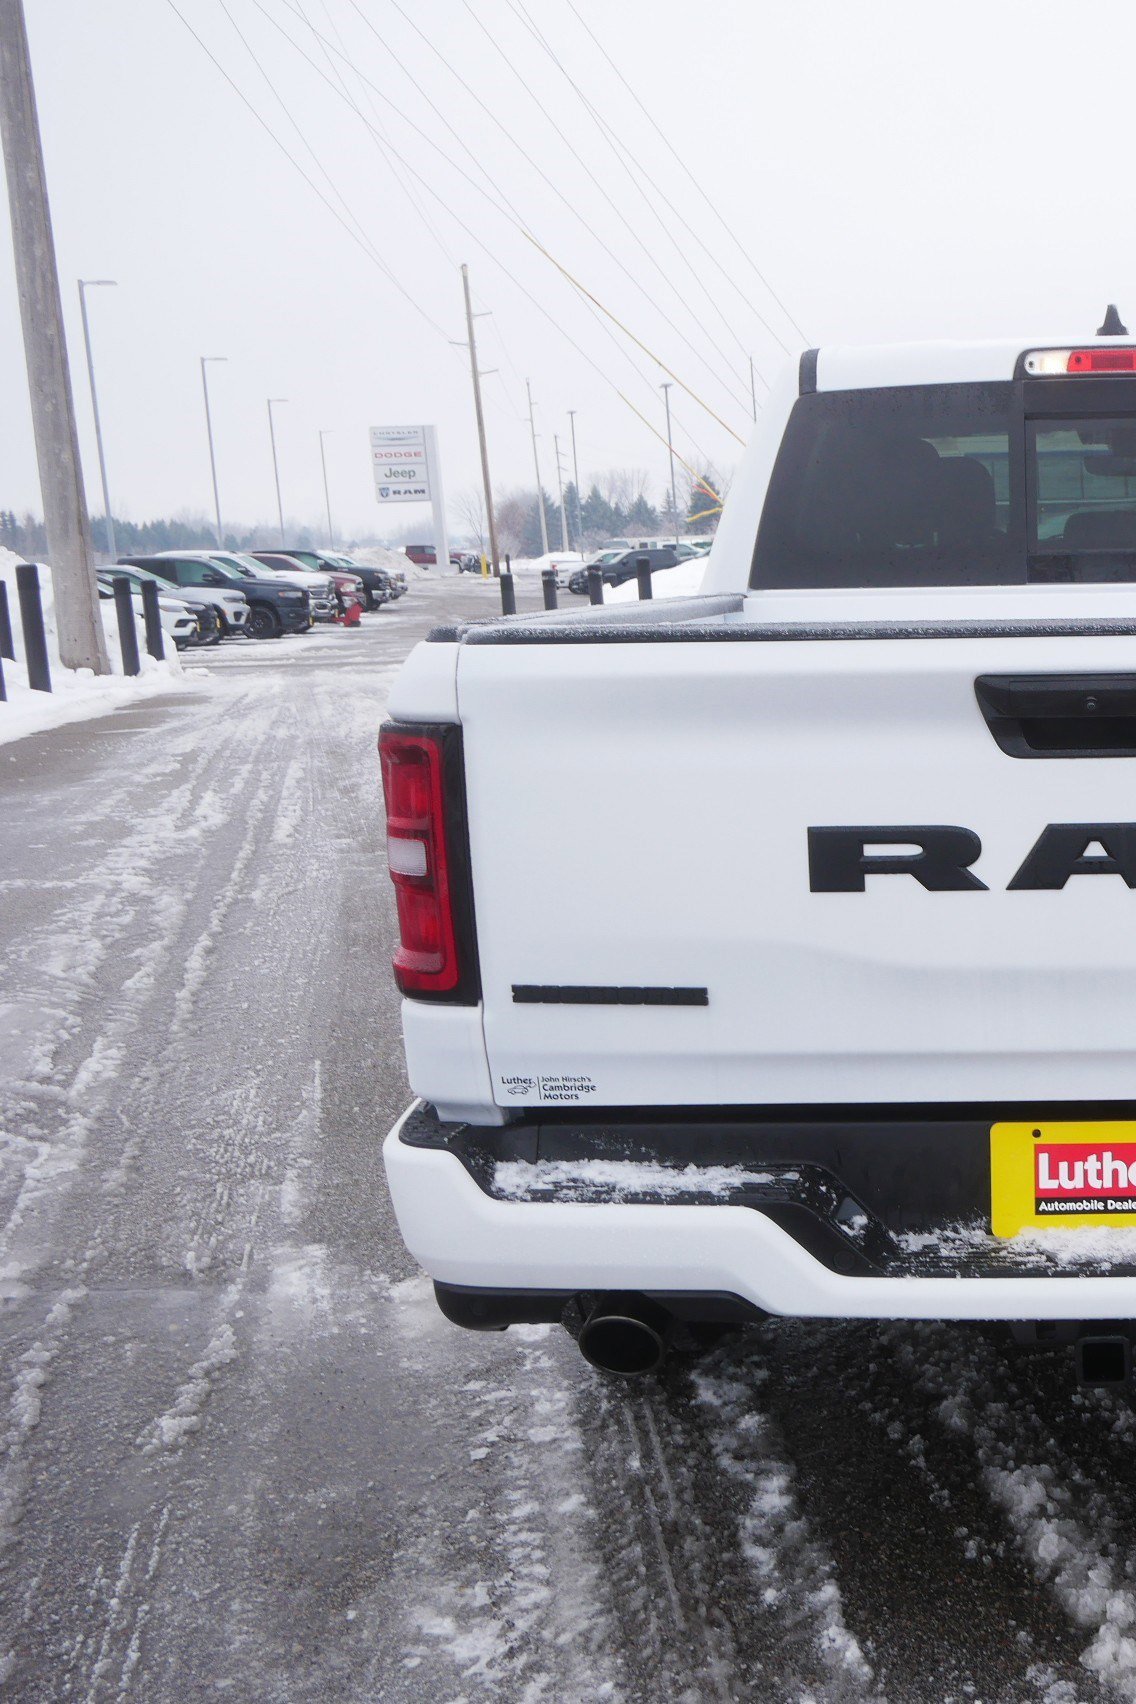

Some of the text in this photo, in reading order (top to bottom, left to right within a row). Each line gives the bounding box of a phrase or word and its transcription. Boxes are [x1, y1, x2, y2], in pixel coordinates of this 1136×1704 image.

[374, 451, 422, 459] DODGE
[384, 468, 416, 479] Jeep
[501, 1076, 532, 1085] Luther
[542, 1084, 597, 1093] Cambridge
[543, 1092, 580, 1100] Motors
[1038, 1199, 1105, 1212] Automobile
